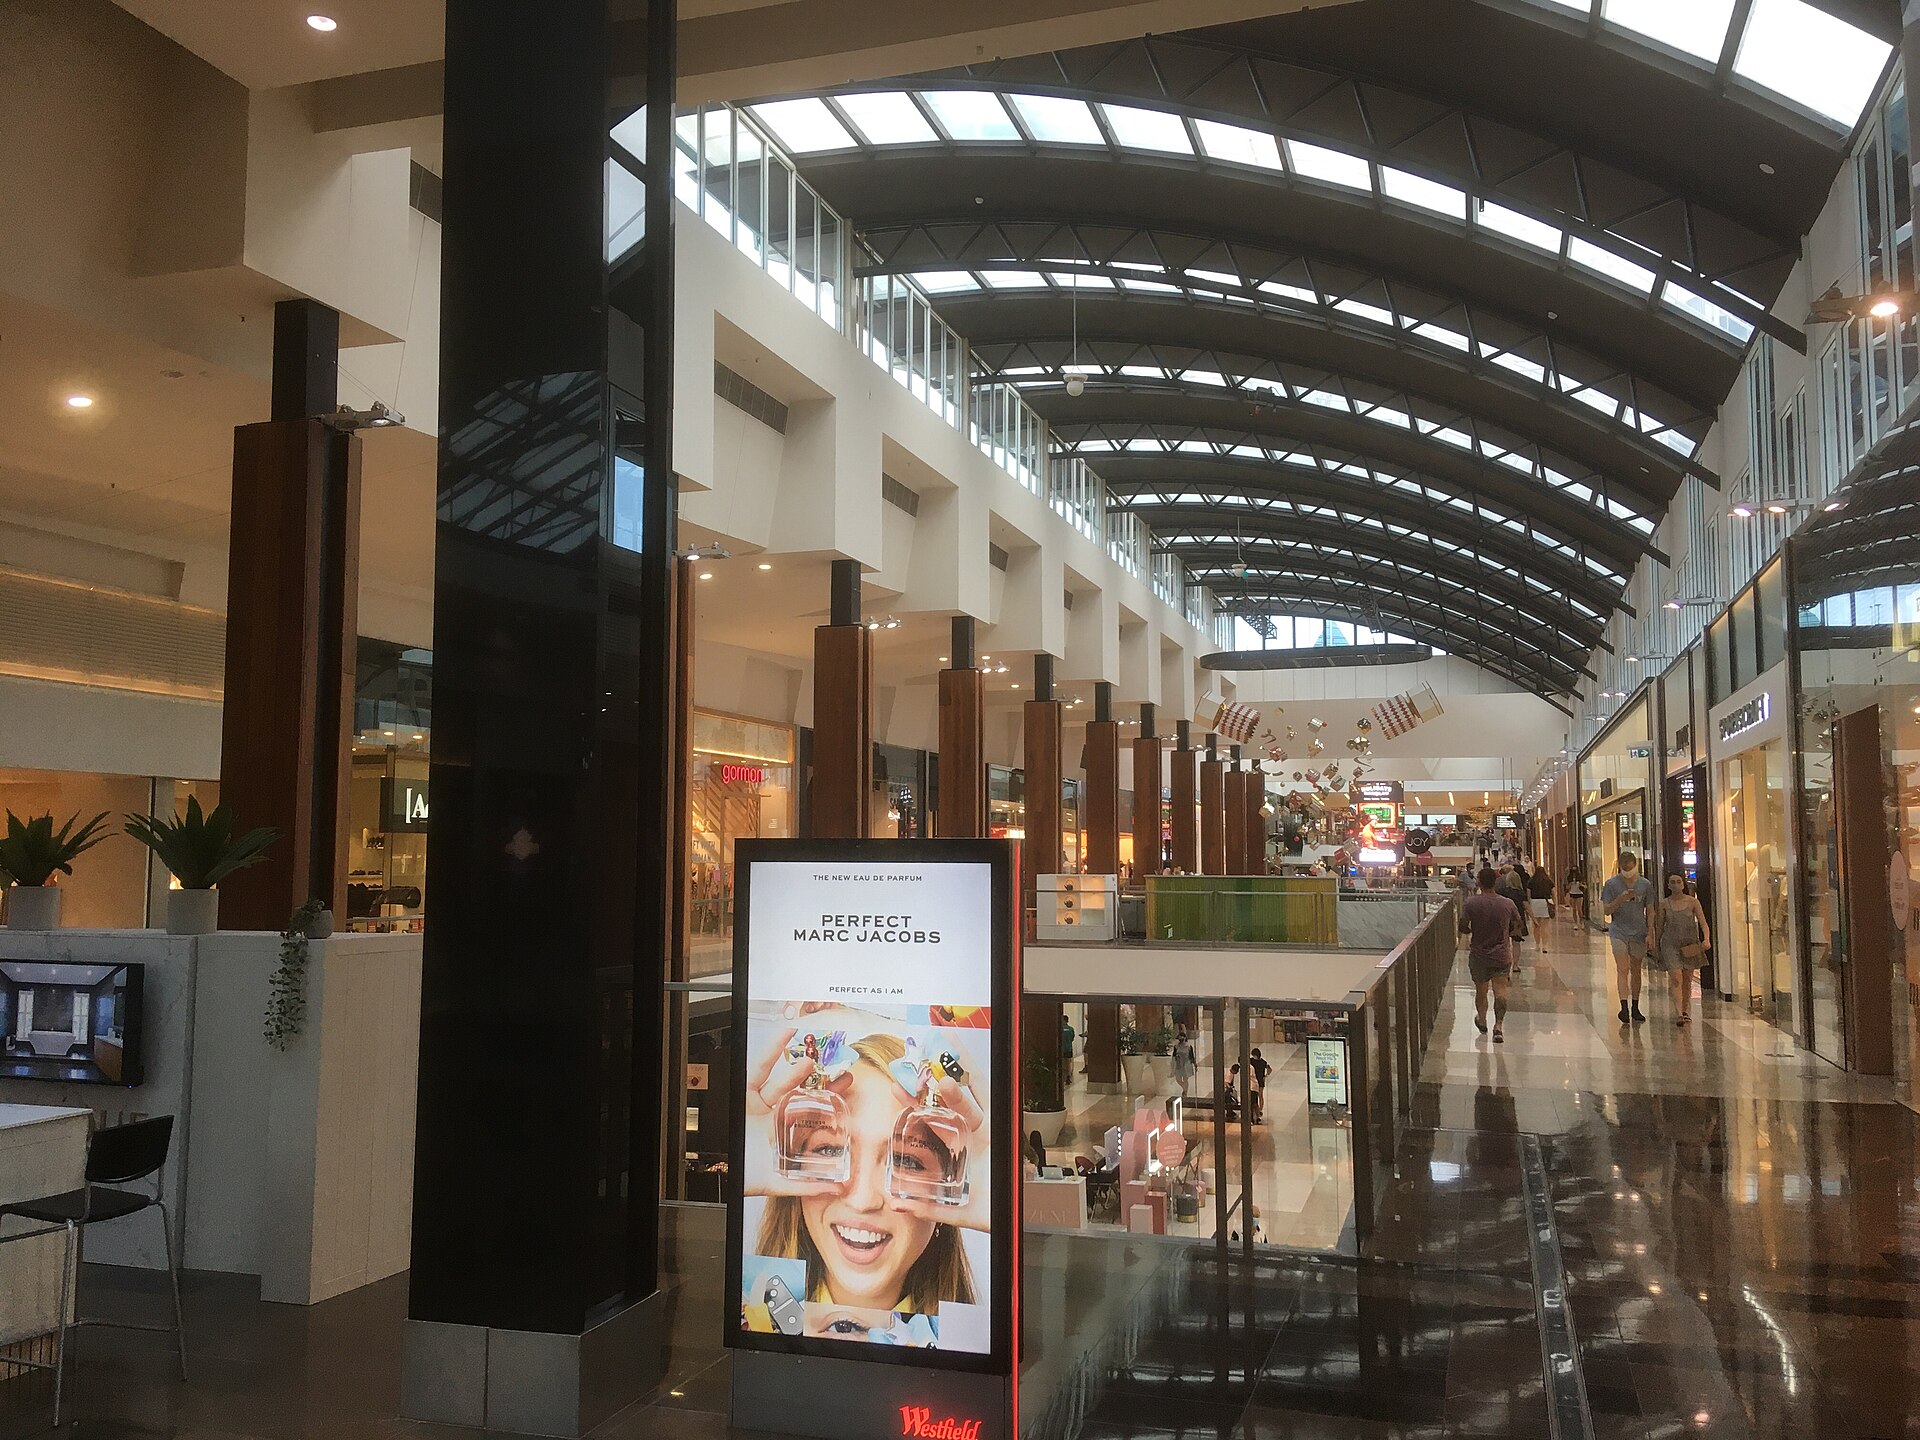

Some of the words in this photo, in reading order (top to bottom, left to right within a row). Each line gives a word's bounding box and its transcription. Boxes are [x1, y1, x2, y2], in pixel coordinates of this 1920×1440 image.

[722, 764, 763, 784] gorman
[1407, 837, 1429, 847] JOY
[812, 874, 830, 882] THE
[831, 874, 851, 882] NEW
[853, 874, 871, 882] EAU
[886, 875, 922, 883] PARFUM
[821, 914, 912, 928] PERFECT
[793, 928, 850, 942] MARC
[856, 929, 941, 944] JACOBS
[829, 986, 868, 994] PERFECT
[870, 987, 883, 995] AS
[884, 987, 888, 995] I
[890, 987, 903, 995] AM
[899, 1405, 982, 1440] Westfield
